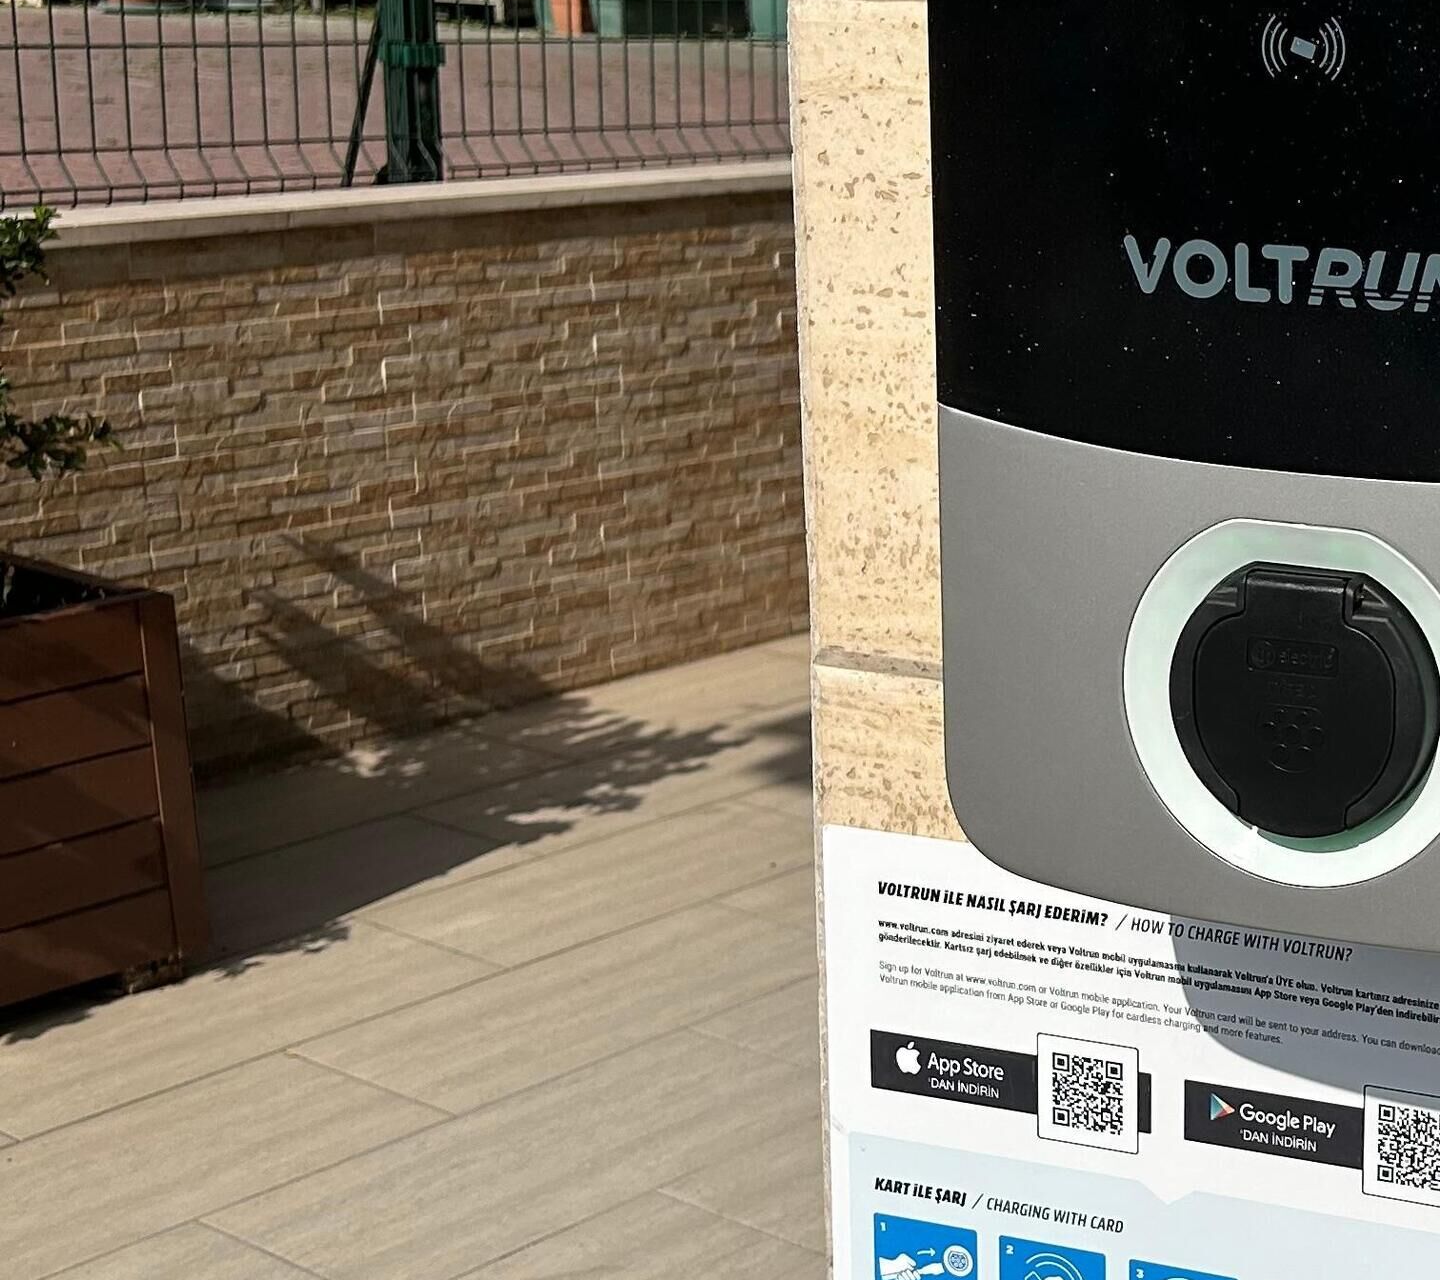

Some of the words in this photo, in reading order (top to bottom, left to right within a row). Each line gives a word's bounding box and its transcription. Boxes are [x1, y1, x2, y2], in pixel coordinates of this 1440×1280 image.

[878, 880, 941, 902] VOLTRUN
[966, 893, 1005, 912] NASIL
[1008, 899, 1042, 919] ŞARJ
[1044, 904, 1108, 926] EDERİM?
[1130, 917, 1165, 934] HOW
[1167, 921, 1184, 938] TO
[1187, 925, 1240, 945] CHARGE
[1243, 932, 1279, 951] WITH
[1283, 938, 1353, 961] VOLTRUN?
[927, 1052, 960, 1076] App
[962, 1057, 1004, 1081] Store
[1239, 1103, 1300, 1131] Google
[1303, 1114, 1336, 1138] Play
[874, 1176, 911, 1195] KART
[934, 1187, 967, 1207] ŞARJ
[986, 1197, 1050, 1220] CHARGING
[1053, 1209, 1087, 1227] WITH
[1090, 1215, 1123, 1233] CARD
[880, 1221, 886, 1231] 1
[1005, 1244, 1014, 1254] 2
[1136, 1268, 1144, 1278] 3
